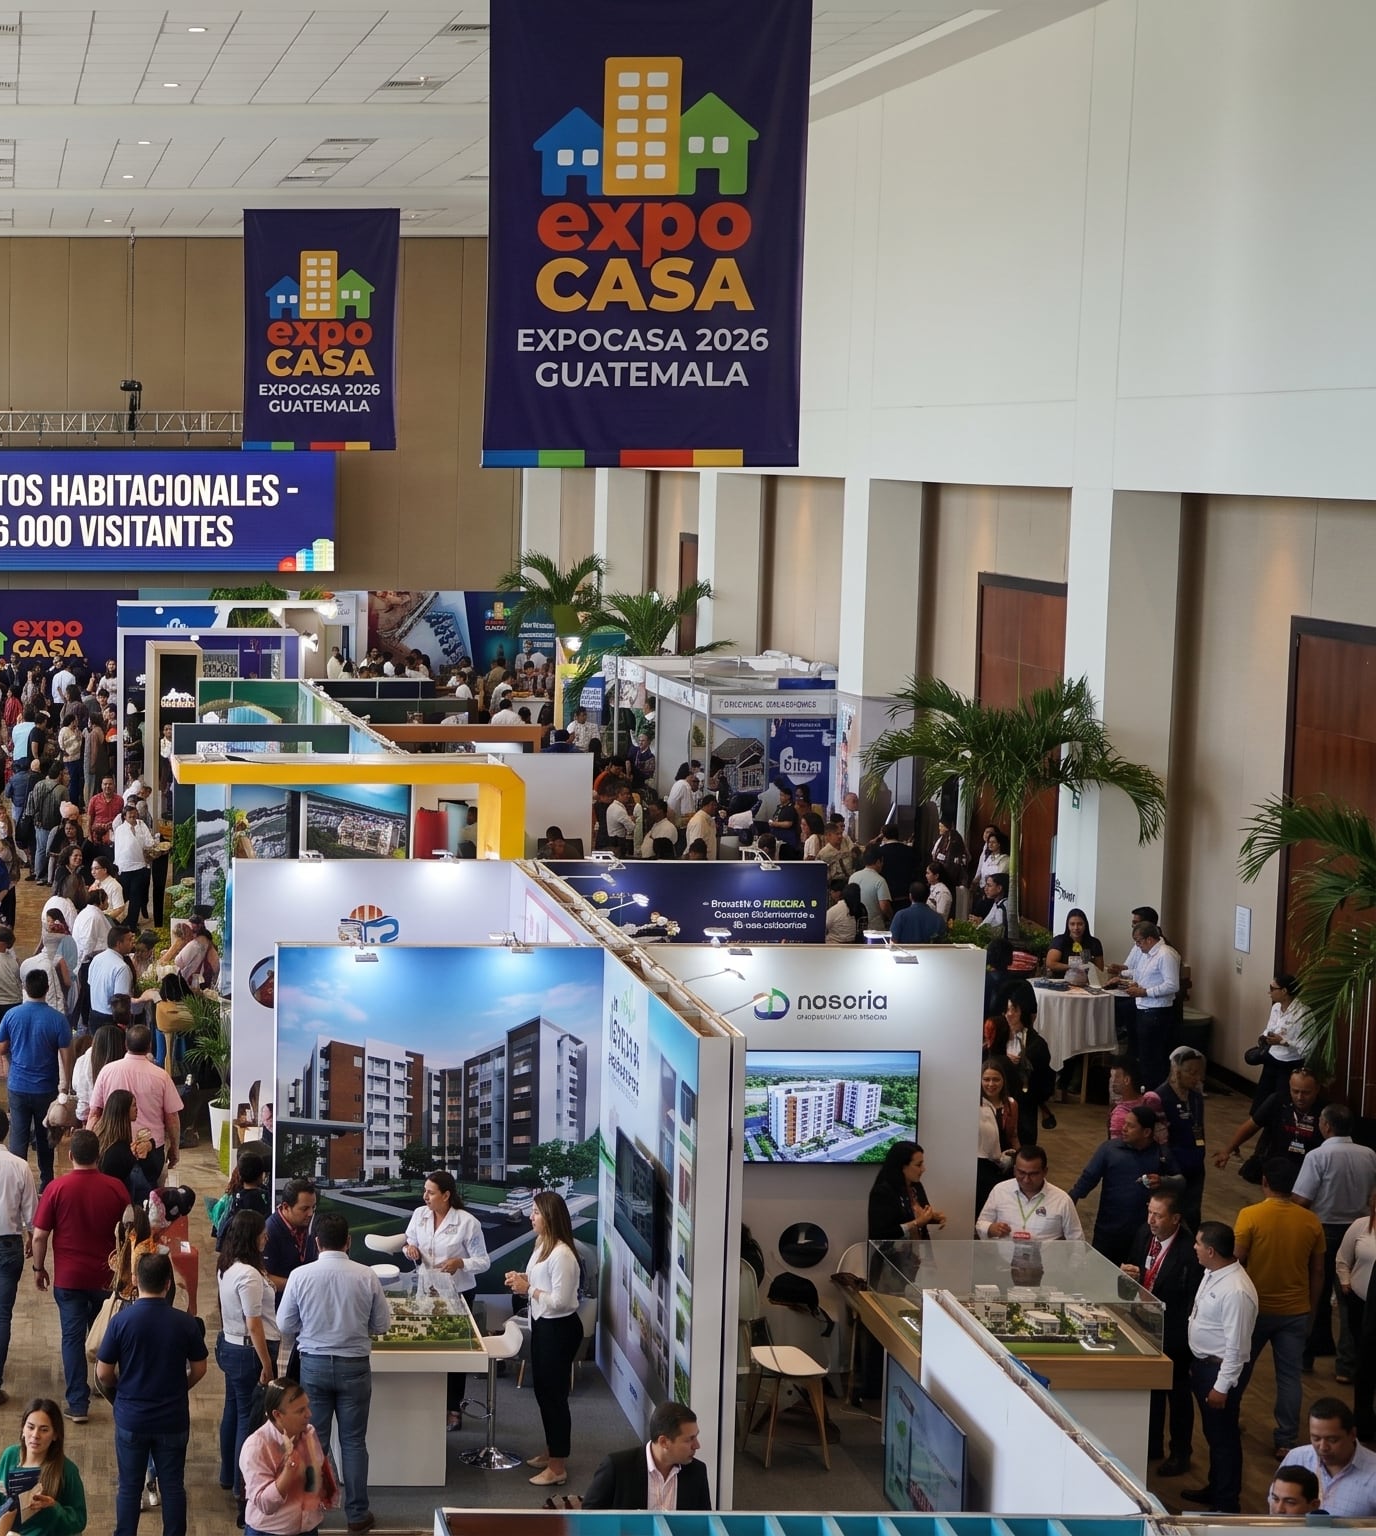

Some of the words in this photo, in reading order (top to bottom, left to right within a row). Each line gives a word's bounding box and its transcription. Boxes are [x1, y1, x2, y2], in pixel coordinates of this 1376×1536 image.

[537, 201, 752, 268] expo
[535, 257, 755, 313] CASA
[267, 321, 373, 355] expo
[517, 328, 688, 353] EXPOCASA
[695, 328, 769, 353] 2026
[266, 348, 375, 377] CASA
[535, 361, 750, 388] GUATEMALA
[258, 383, 342, 397] EXPOCASA
[344, 383, 381, 397] 2026
[268, 399, 371, 413] GUATEMALA
[50, 473, 280, 507] HABITACIONALES
[79, 514, 234, 548] VISITANTES
[12, 619, 84, 643] expo
[12, 639, 84, 658] CASA
[797, 989, 888, 1010] nasoria
